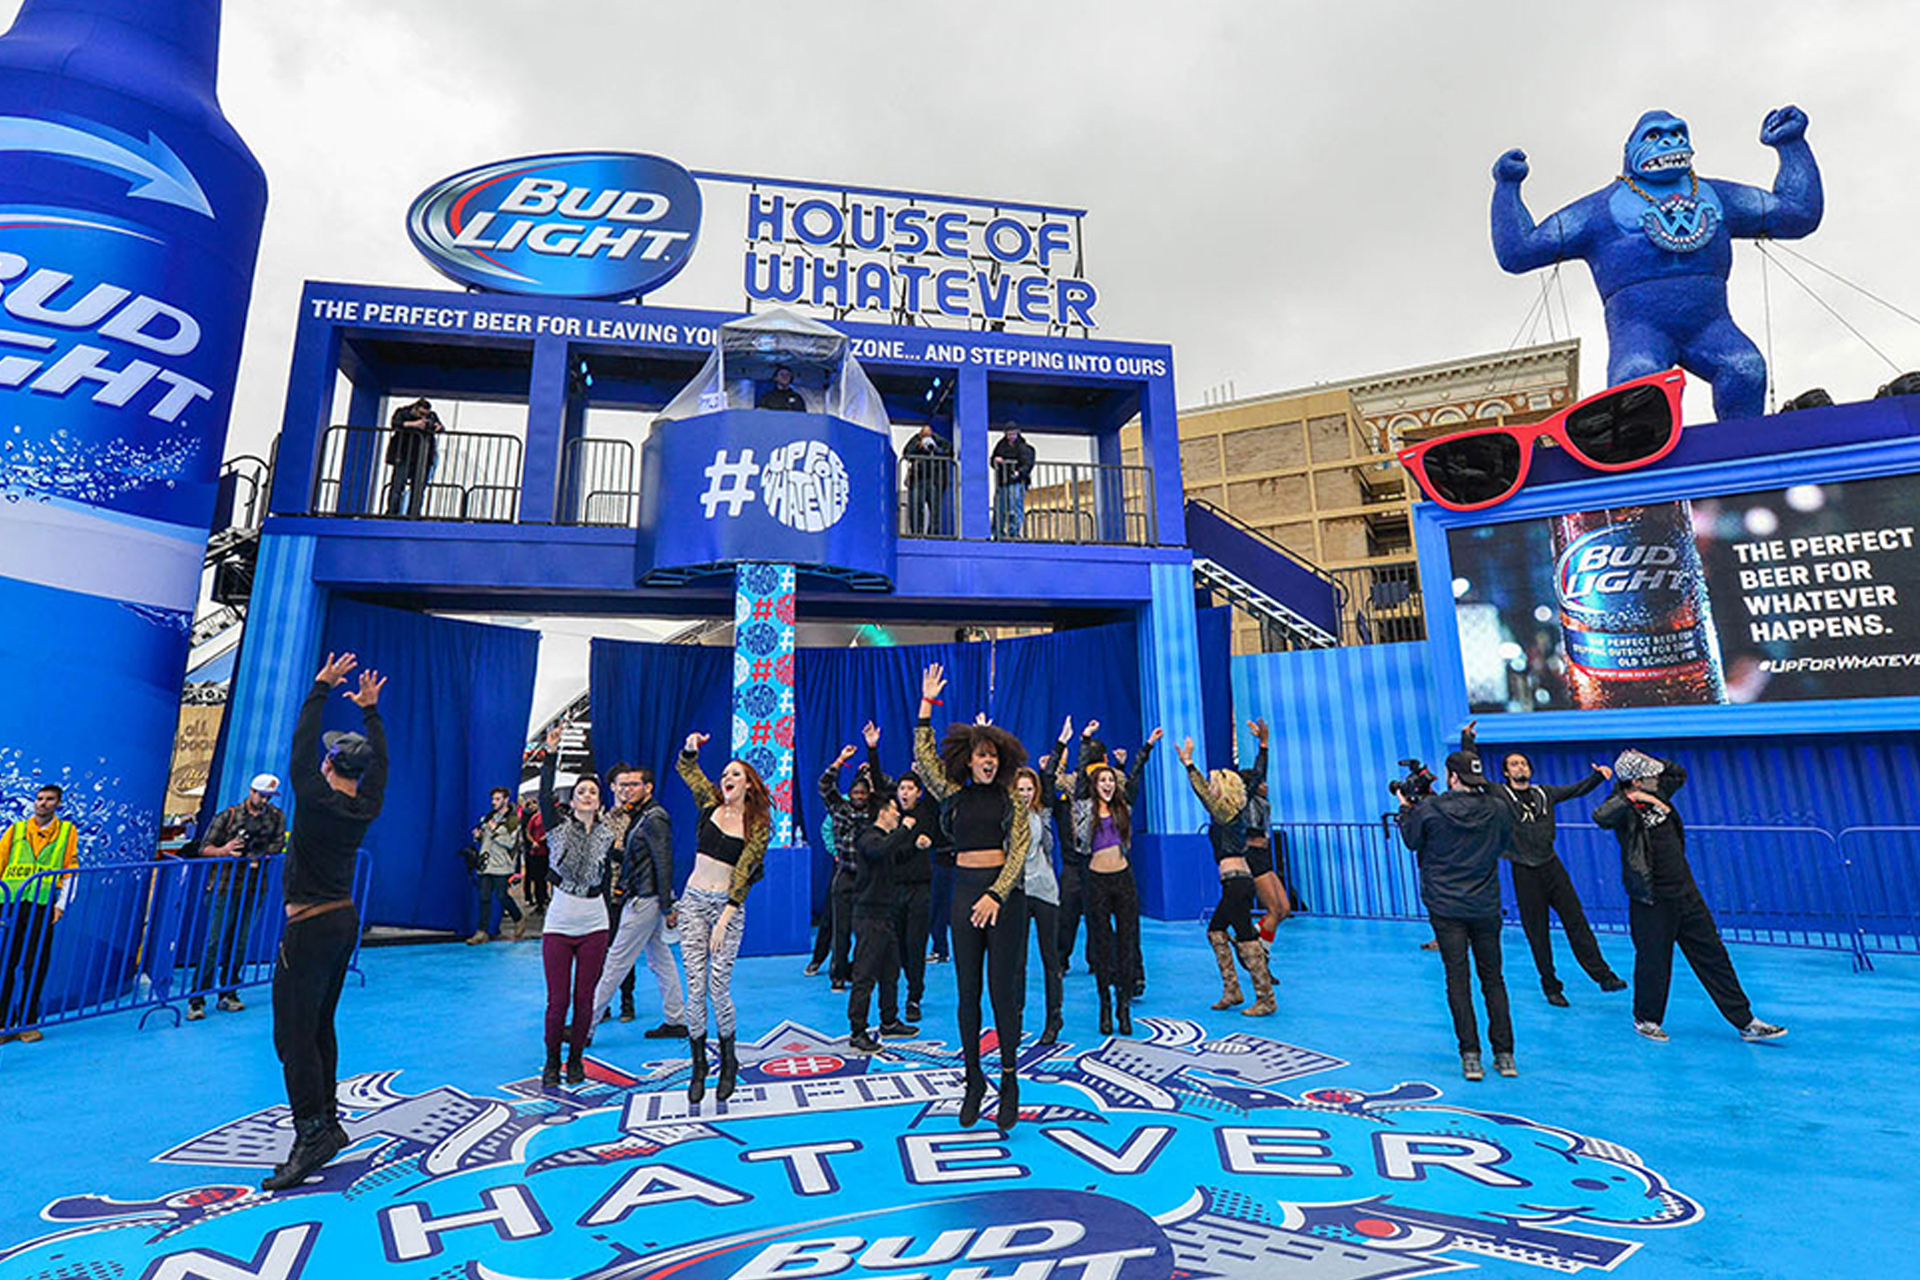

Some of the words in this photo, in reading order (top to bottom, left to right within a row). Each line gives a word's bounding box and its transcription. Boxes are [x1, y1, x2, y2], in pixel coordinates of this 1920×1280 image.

[499, 177, 670, 221] BUD
[452, 212, 690, 261] LIGHT
[747, 193, 970, 259] HOUSE
[983, 217, 1070, 267] OF
[743, 251, 1097, 326] WHATEVER
[312, 300, 357, 320] THE
[363, 303, 469, 329] PERFECT
[473, 312, 531, 333] BEER
[536, 316, 581, 336] FOR
[586, 320, 677, 343] LEAVING
[925, 344, 966, 363] AND
[970, 347, 1063, 370] STEPPING
[1068, 354, 1111, 374] INTO
[1115, 357, 1166, 377] OURS
[1577, 544, 1677, 572] BUD
[1732, 540, 1787, 563] THE
[1790, 527, 1914, 558] PERFECT
[1563, 570, 1683, 600] LIGHT
[1739, 565, 1810, 590] BEER
[1814, 559, 1873, 584] FOR
[1743, 585, 1898, 616] WHATEVER
[1750, 614, 1894, 642] HAPPENS.
